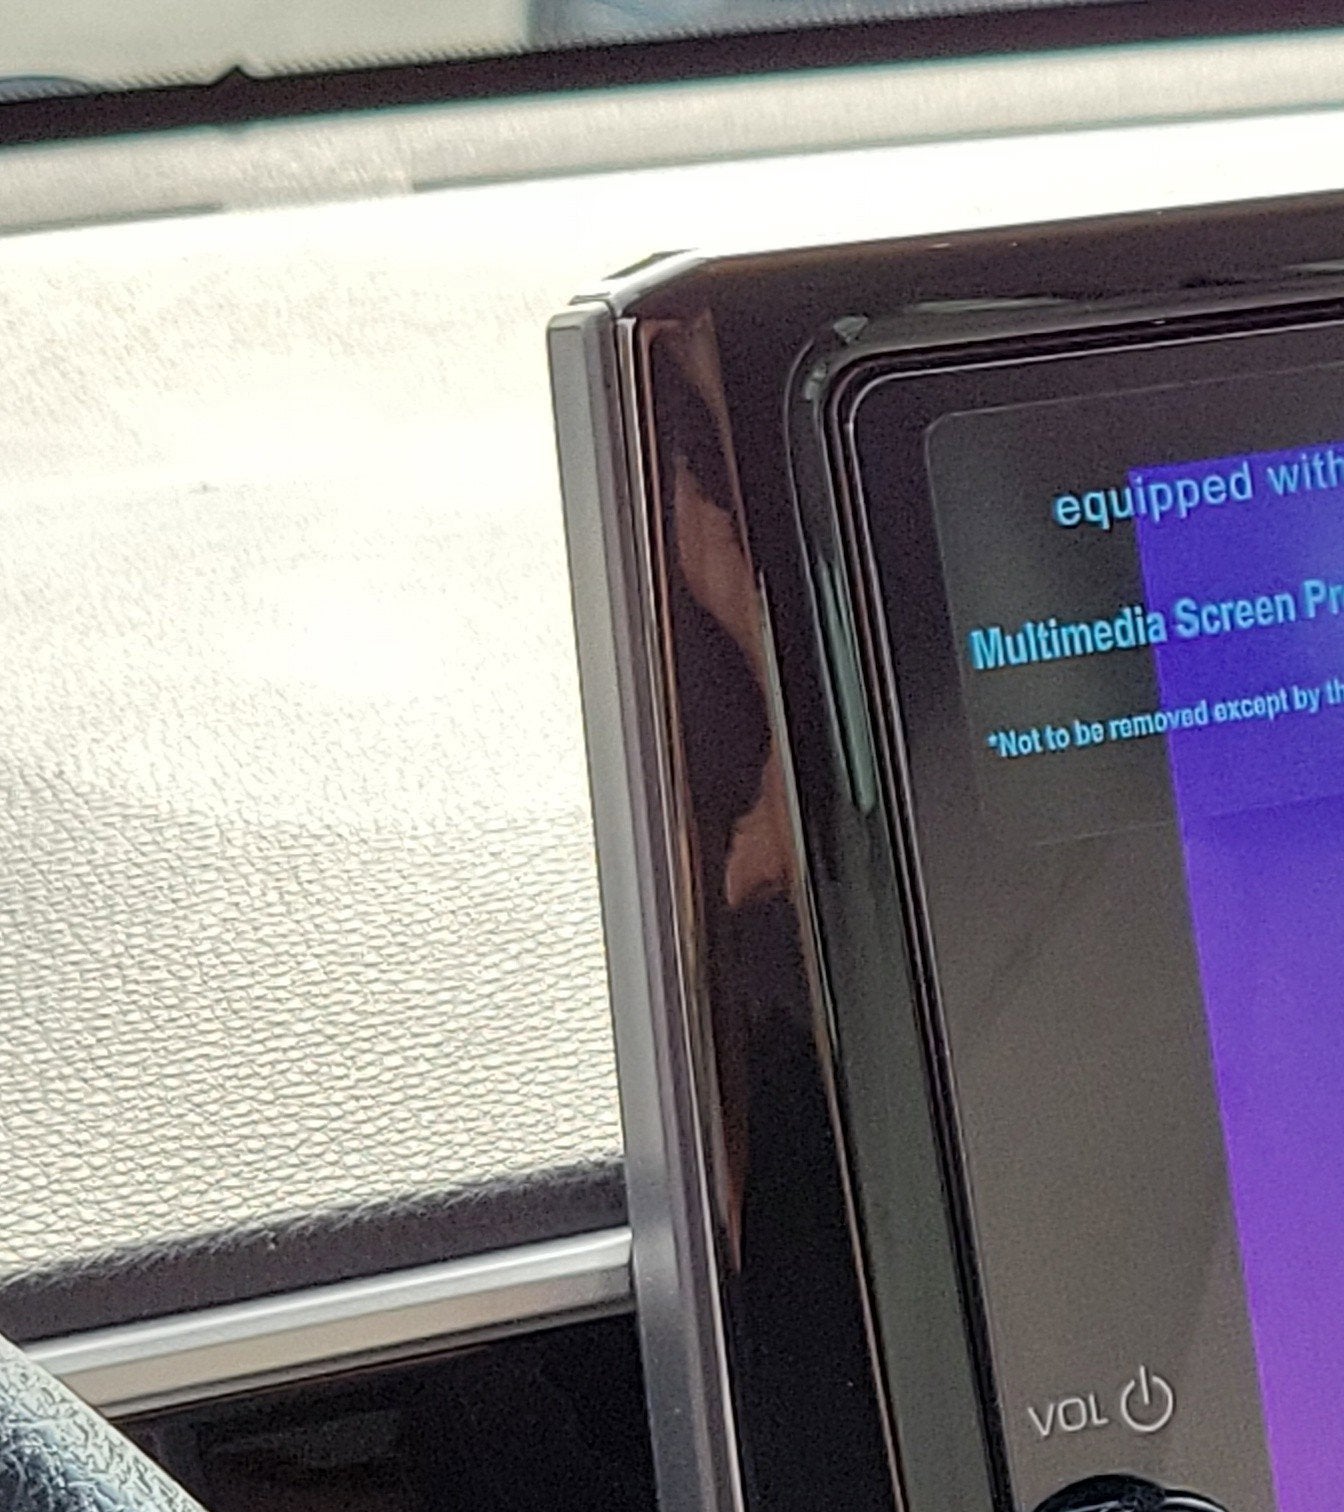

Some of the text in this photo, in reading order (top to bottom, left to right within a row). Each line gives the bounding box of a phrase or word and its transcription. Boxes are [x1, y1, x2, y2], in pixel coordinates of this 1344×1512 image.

[1054, 463, 1254, 531] equipped
[969, 605, 1167, 671] Multimedia
[1174, 591, 1297, 638] Screen
[1044, 724, 1071, 751] to
[1074, 718, 1104, 745] be
[1108, 700, 1210, 741] removed
[1212, 689, 1290, 729] except
[1294, 683, 1321, 715] by
[1027, 1391, 1110, 1438] VOL
